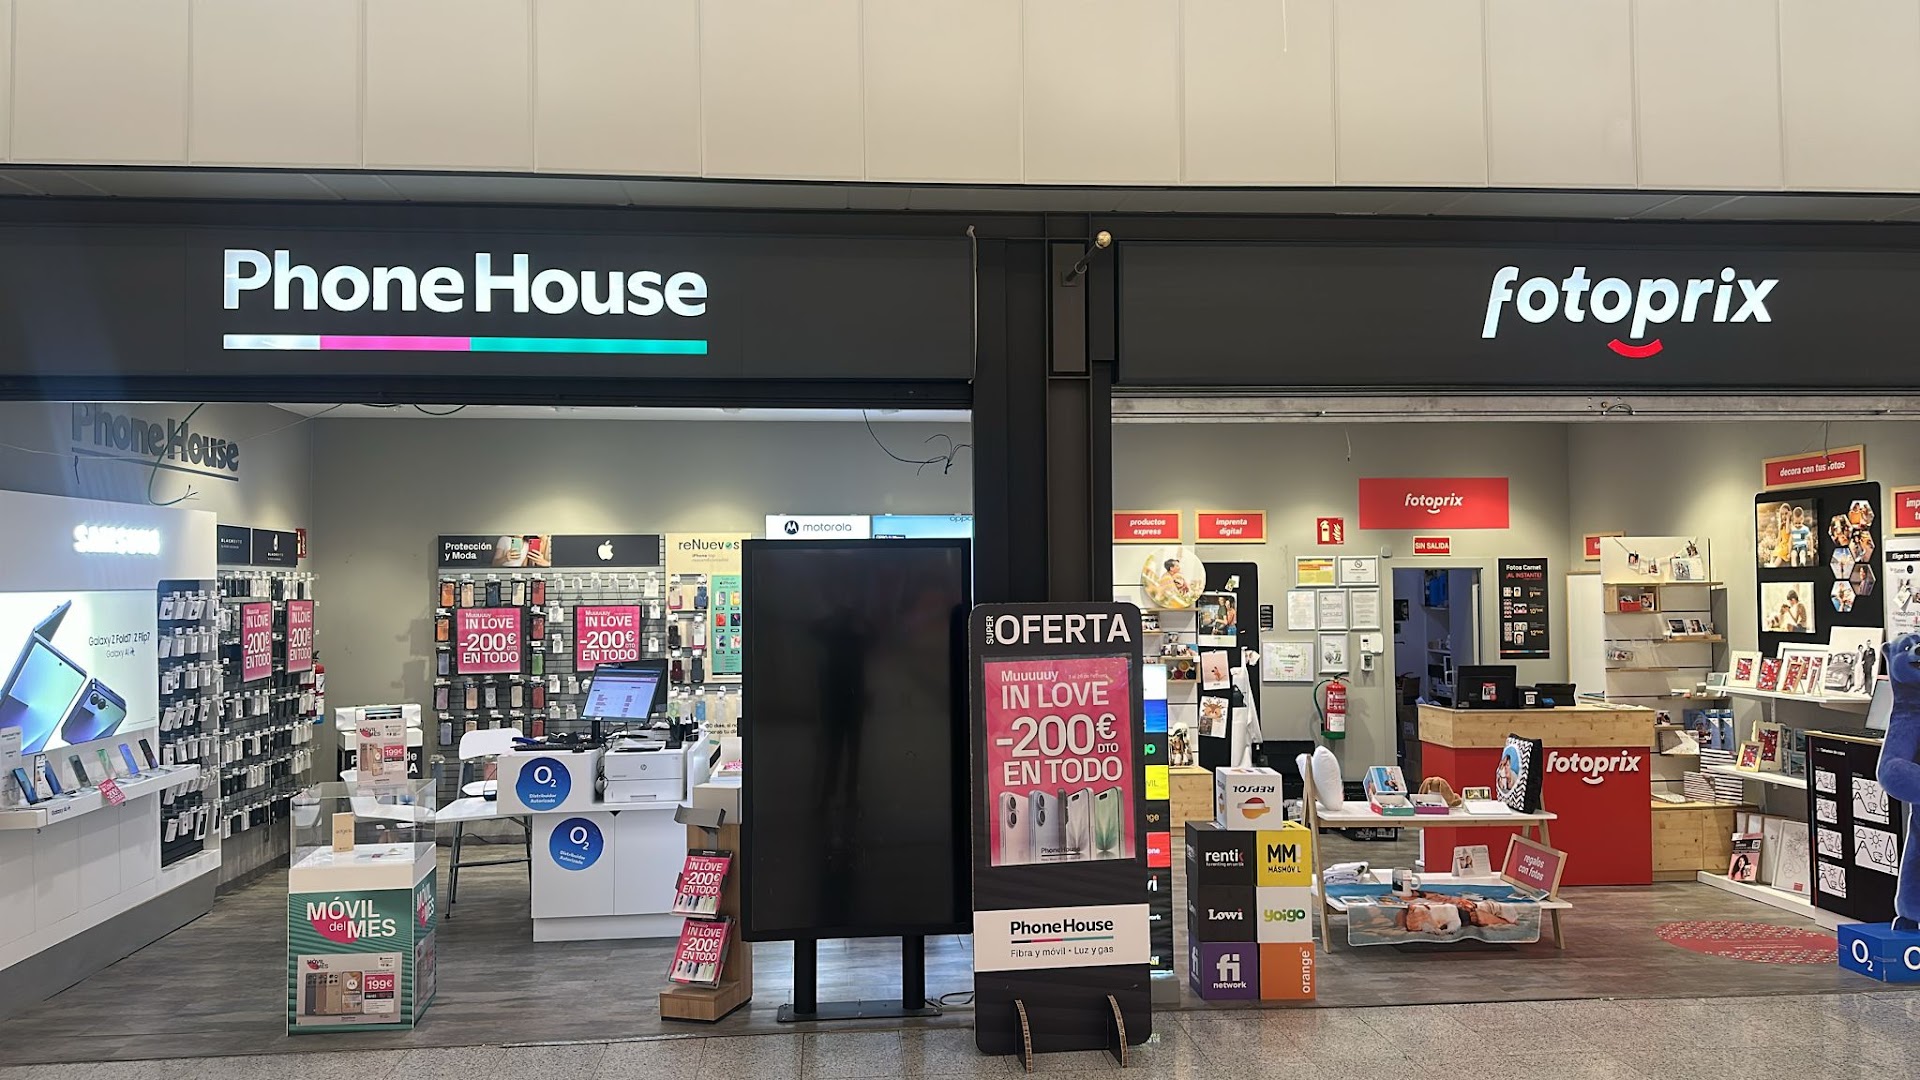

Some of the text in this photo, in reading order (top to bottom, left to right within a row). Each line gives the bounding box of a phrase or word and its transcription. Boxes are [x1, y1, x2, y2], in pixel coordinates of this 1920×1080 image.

[1481, 266, 1780, 339] fotoprix
[1780, 467, 1801, 477] decora
[1802, 465, 1815, 474] con
[1815, 464, 1827, 472] tus
[1405, 493, 1463, 509] fotoprix
[802, 523, 852, 532] motorola
[1129, 518, 1166, 527] productos
[1215, 518, 1248, 527] imprenta
[1133, 528, 1162, 536] express
[1219, 528, 1243, 536] digital
[445, 542, 492, 551] Protección
[1415, 542, 1449, 550] SIN SALIDA
[444, 552, 477, 561] y Moda
[246, 613, 269, 628] IN LOVE
[291, 611, 311, 623] IN LOVE
[465, 617, 514, 629] IN LOVE
[585, 615, 633, 627] IN LOVE
[985, 615, 994, 645] SUPER
[994, 613, 1132, 645] OFERTA
[89, 636, 111, 647] Galaxy
[244, 631, 270, 654] -200€
[460, 632, 517, 652] -200€
[580, 630, 635, 649] -200€
[246, 652, 271, 669] EN TODO
[289, 647, 311, 661] EN TODO
[463, 651, 519, 664] EN TODO
[582, 649, 637, 661] EN TODO
[1001, 681, 1109, 710] IN LOVE
[996, 712, 1117, 758] -200€
[1097, 743, 1119, 754] DTO
[1545, 750, 1642, 778] fotoprix
[1003, 756, 1123, 786] EN TODO
[688, 861, 723, 871] IN LOVE
[1523, 855, 1545, 869] regalos
[684, 871, 721, 885] -200€
[1518, 865, 1544, 881] con fotos
[682, 885, 718, 895] EN TODO
[306, 896, 381, 921] MÓVIL
[1208, 908, 1244, 920] Lowi
[1264, 908, 1306, 922] yoigo
[328, 918, 397, 939] del MES
[687, 926, 722, 938] IN LOVE
[683, 937, 720, 952] -200€
[681, 950, 717, 962] EN TODO
[1010, 946, 1114, 958] Fibra y móvil Luz y gas
[1216, 953, 1241, 982] fi
[1301, 950, 1313, 994] orange
[366, 979, 393, 990] 199€
[1212, 981, 1247, 989] network
